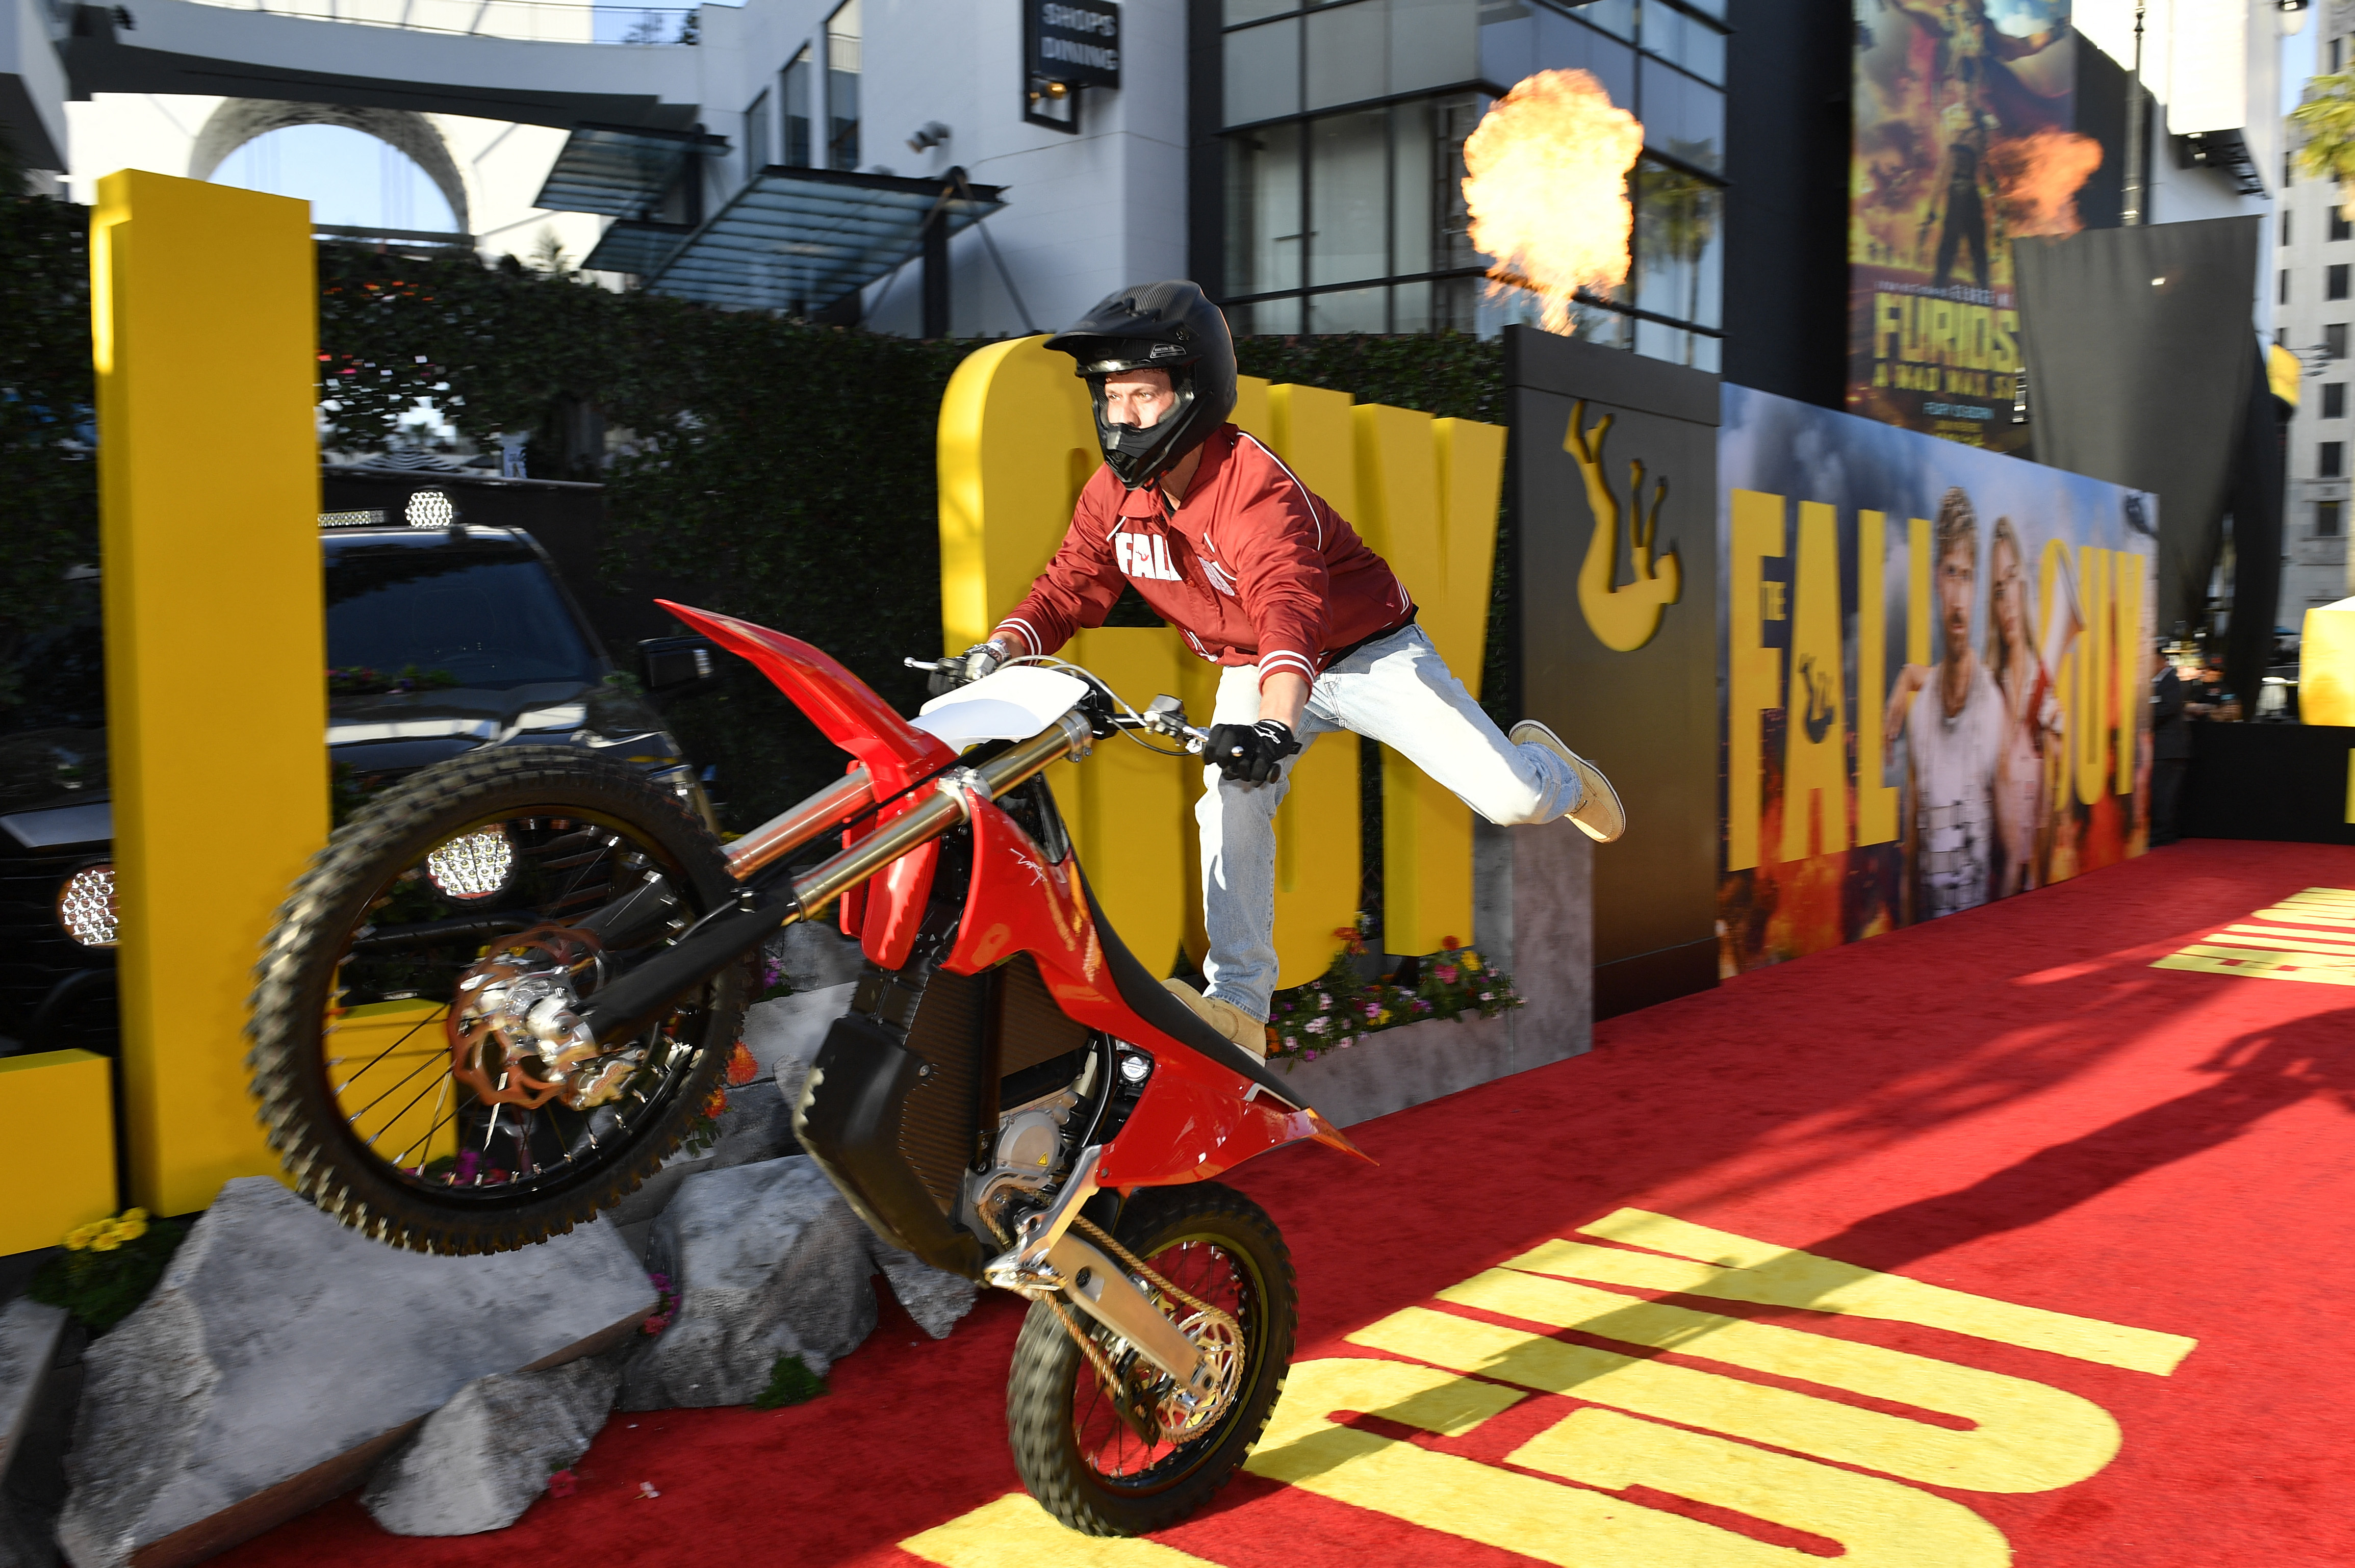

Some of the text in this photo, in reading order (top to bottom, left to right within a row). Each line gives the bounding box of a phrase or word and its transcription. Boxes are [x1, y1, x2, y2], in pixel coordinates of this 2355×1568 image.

[1042, 3, 1117, 37] SHOPS
[1041, 36, 1118, 70] DINING
[1874, 292, 2021, 373] FURIOS
[1115, 532, 1183, 581] FALL
